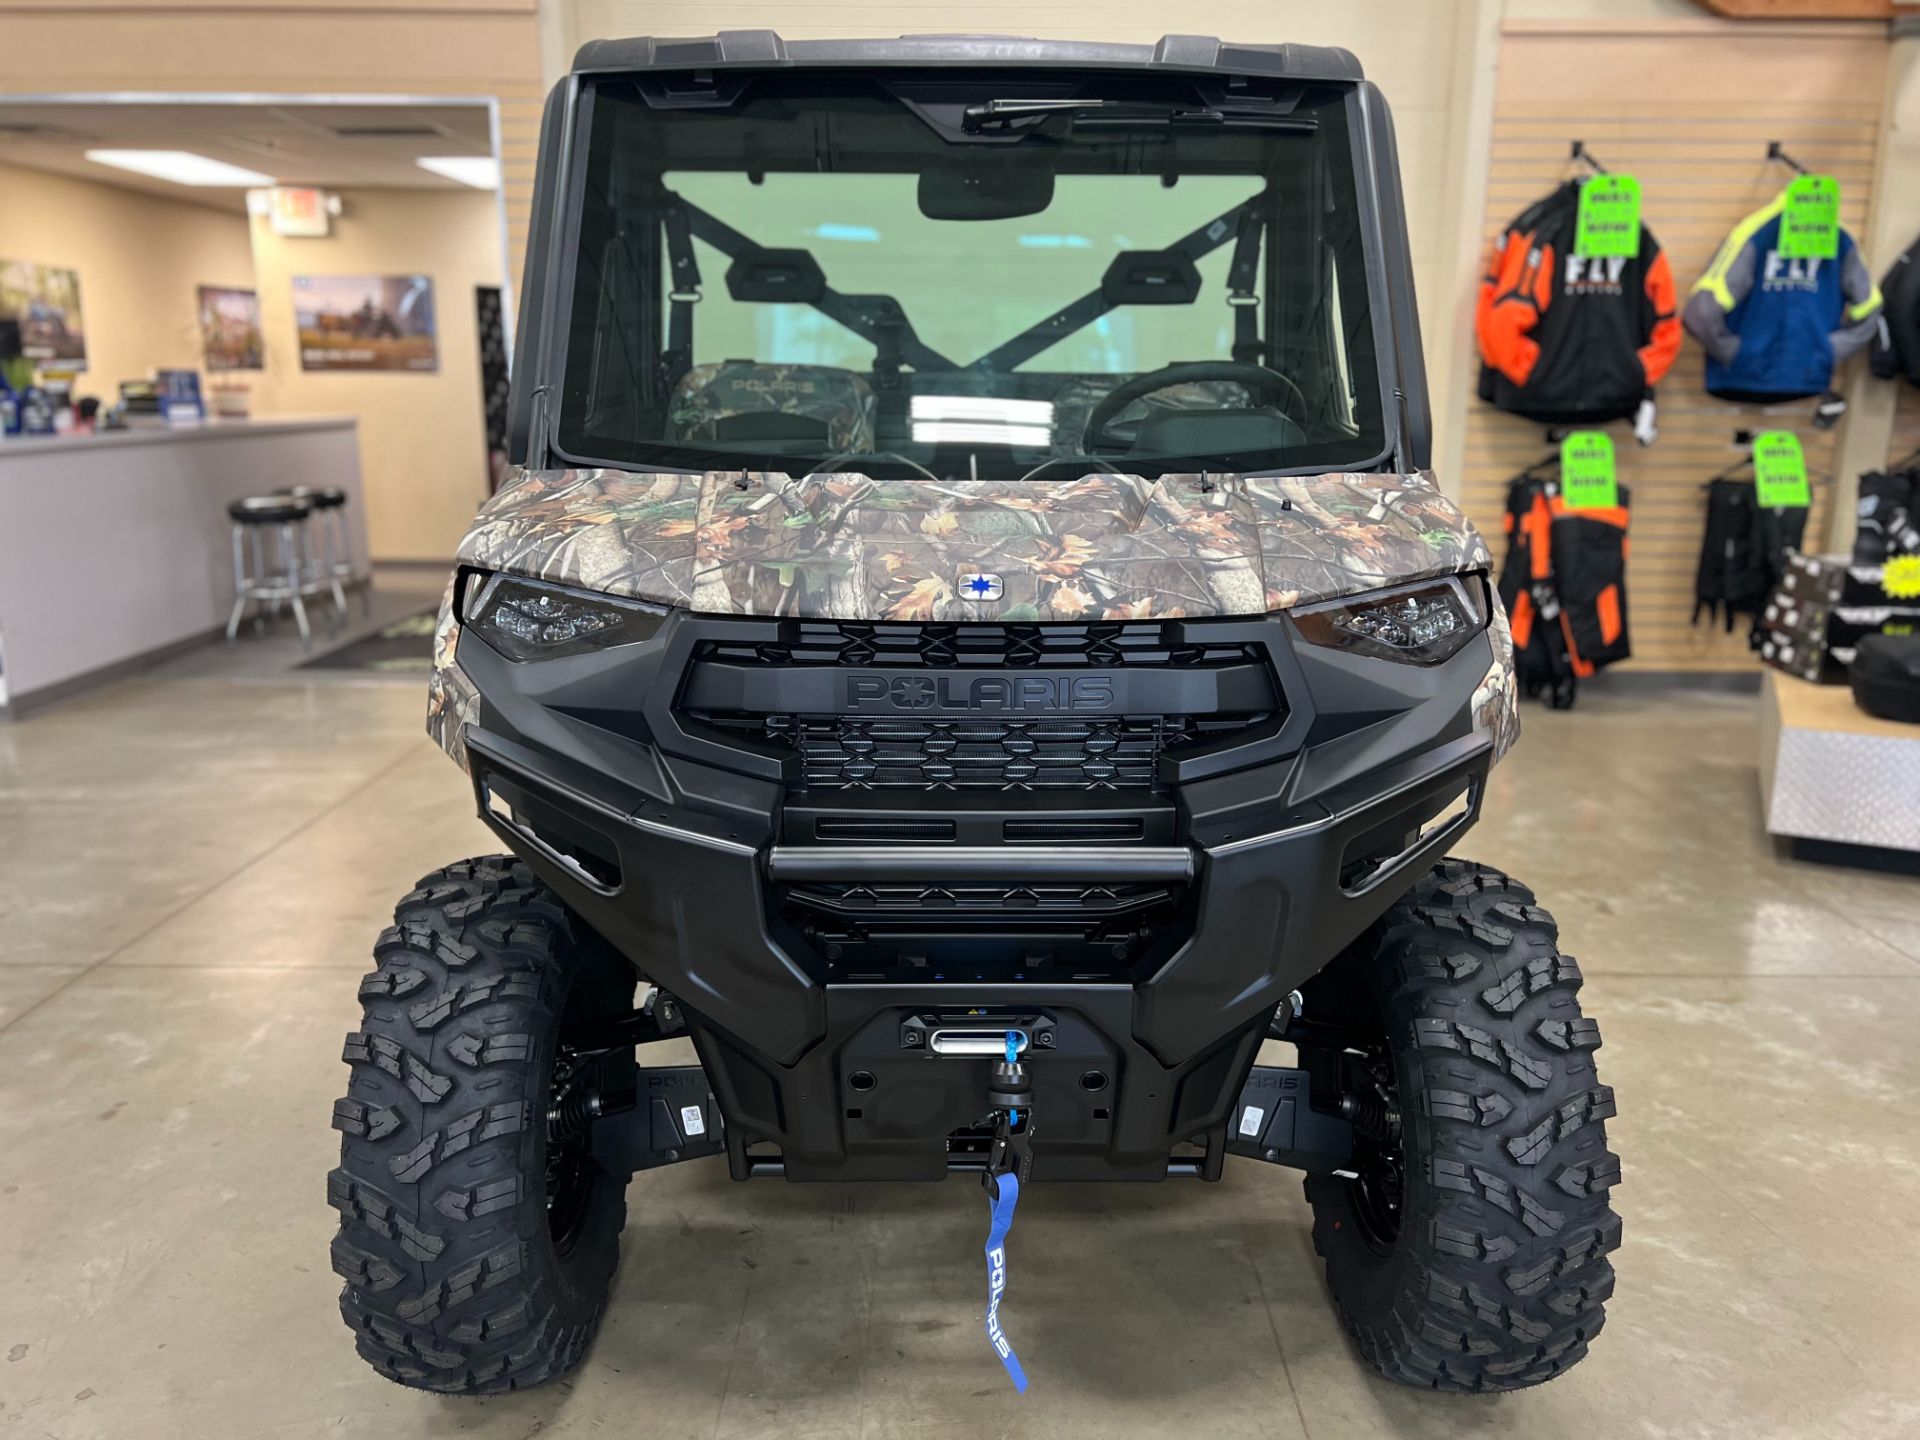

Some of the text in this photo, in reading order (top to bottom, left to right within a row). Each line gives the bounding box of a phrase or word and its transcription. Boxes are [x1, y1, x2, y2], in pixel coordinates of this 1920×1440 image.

[1565, 254, 1627, 282] FLY
[1764, 250, 1821, 280] FLY
[732, 380, 815, 394] POLARIS
[847, 675, 1114, 710] POLARIS
[988, 1247, 1011, 1359] POLARIS
